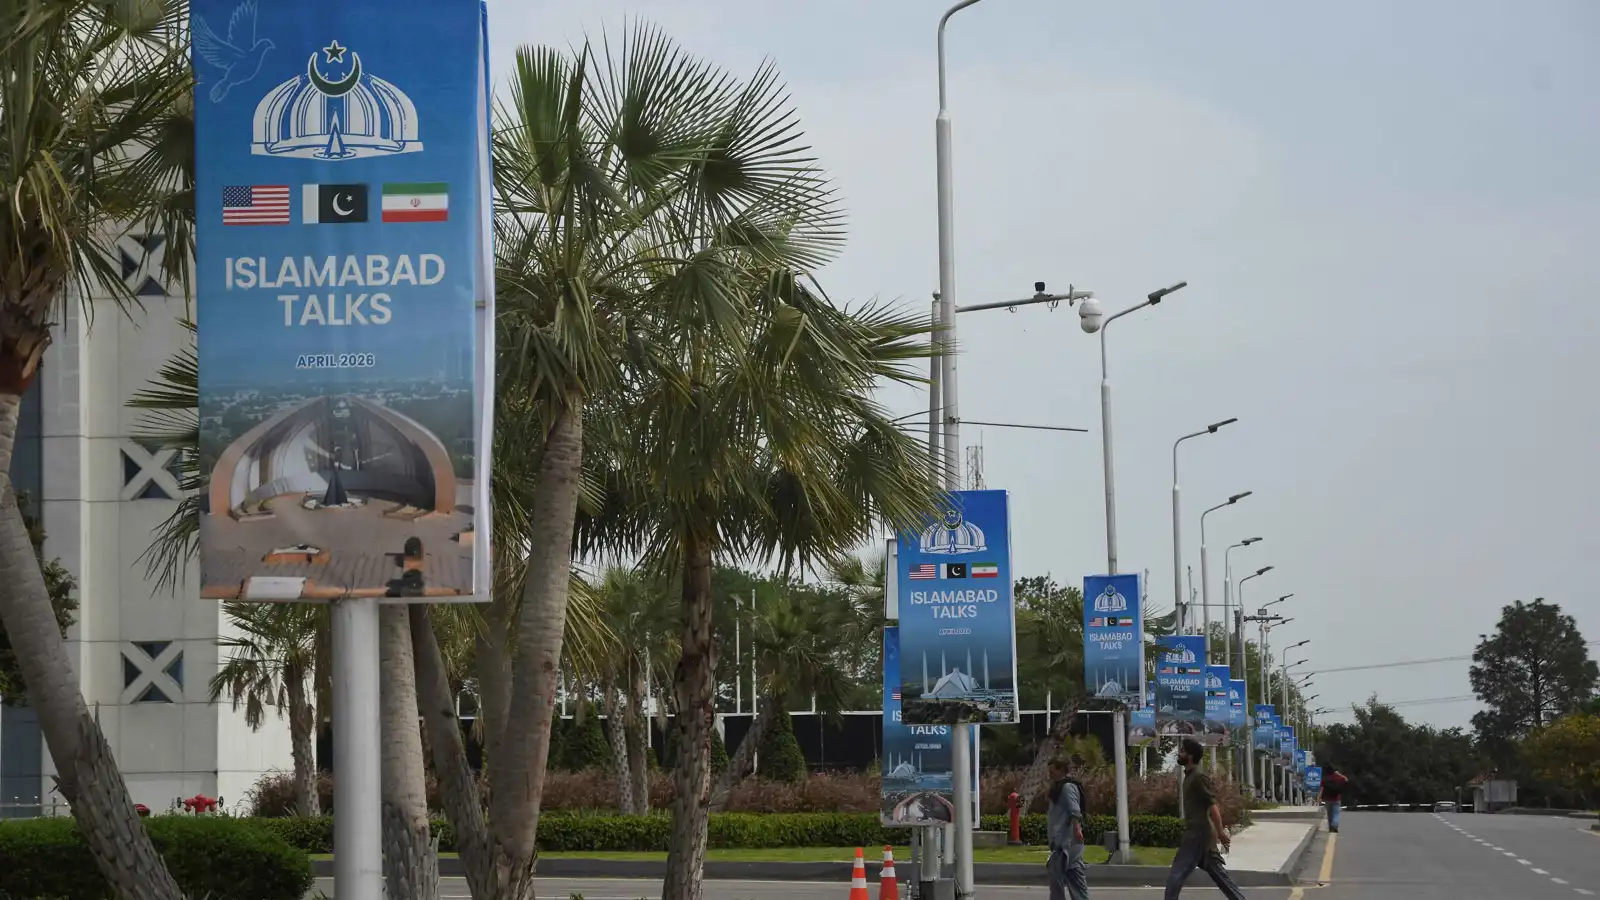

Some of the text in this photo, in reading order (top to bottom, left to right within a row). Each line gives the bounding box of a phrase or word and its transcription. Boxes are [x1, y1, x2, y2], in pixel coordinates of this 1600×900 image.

[225, 253, 446, 290] ISLAMABAD
[277, 293, 392, 327] TALKS
[296, 353, 375, 369] APRIL 2026
[910, 590, 998, 605] ISLAMABAD
[931, 605, 978, 619] TALKS
[1089, 632, 1133, 642] ISLAMABAD
[1100, 641, 1123, 650] TALKS
[1170, 684, 1191, 692] TALKS
